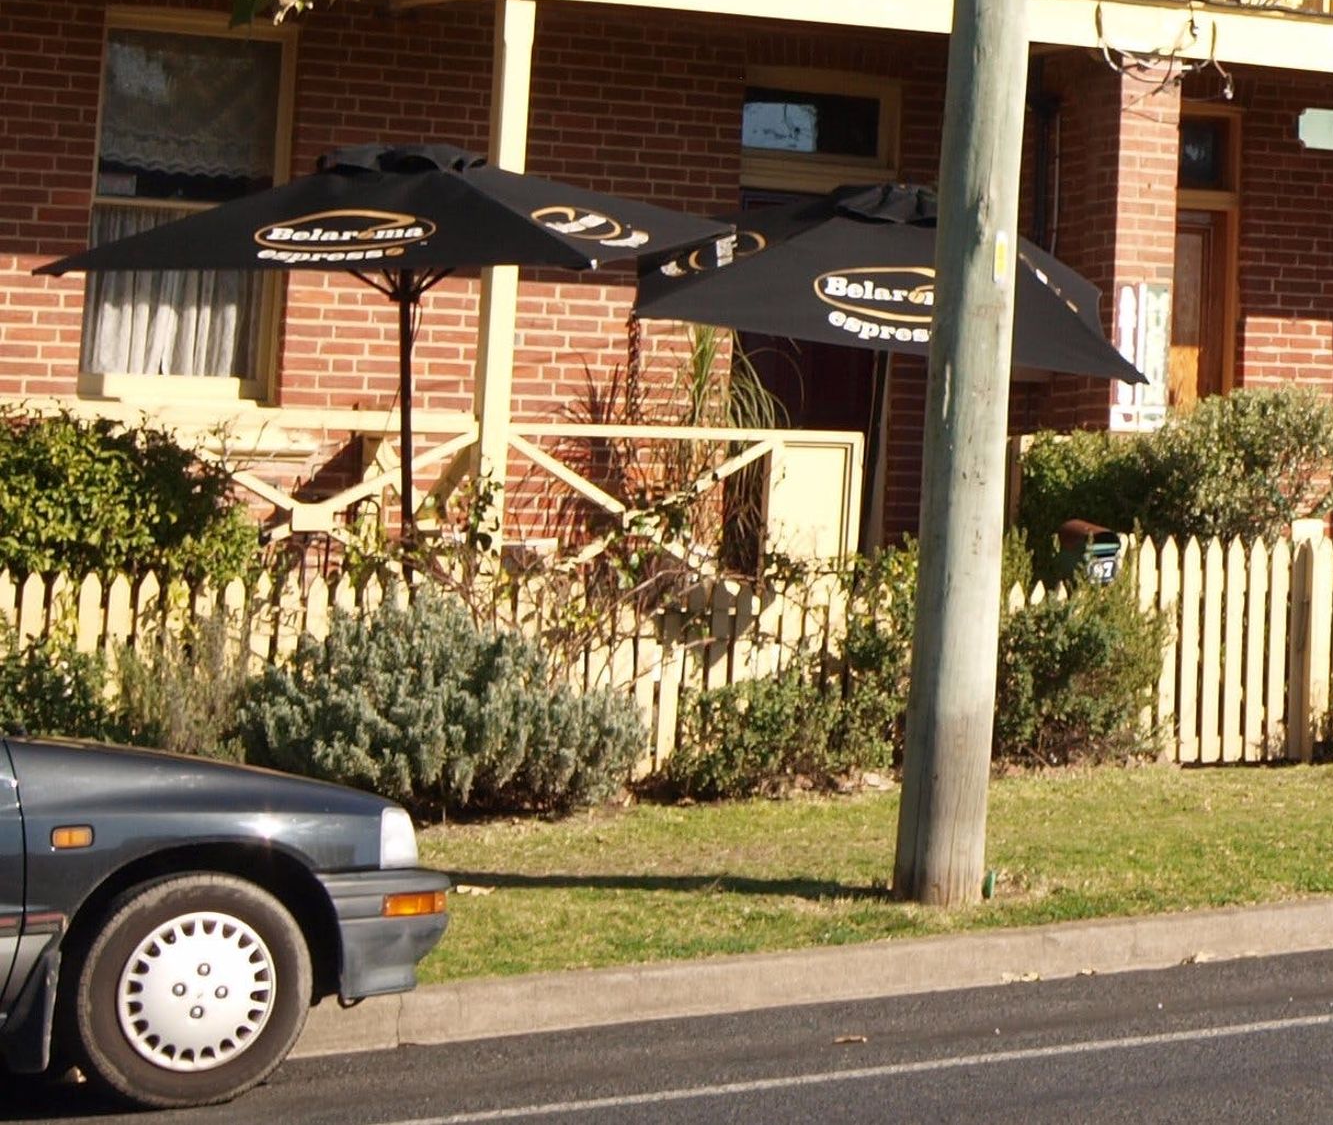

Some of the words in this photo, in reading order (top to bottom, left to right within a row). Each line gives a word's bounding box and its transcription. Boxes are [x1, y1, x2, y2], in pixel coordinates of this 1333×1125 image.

[266, 226, 425, 242] Belaroma
[257, 246, 405, 264] espresso
[823, 275, 935, 306] Belaro
[827, 310, 933, 343] espres
